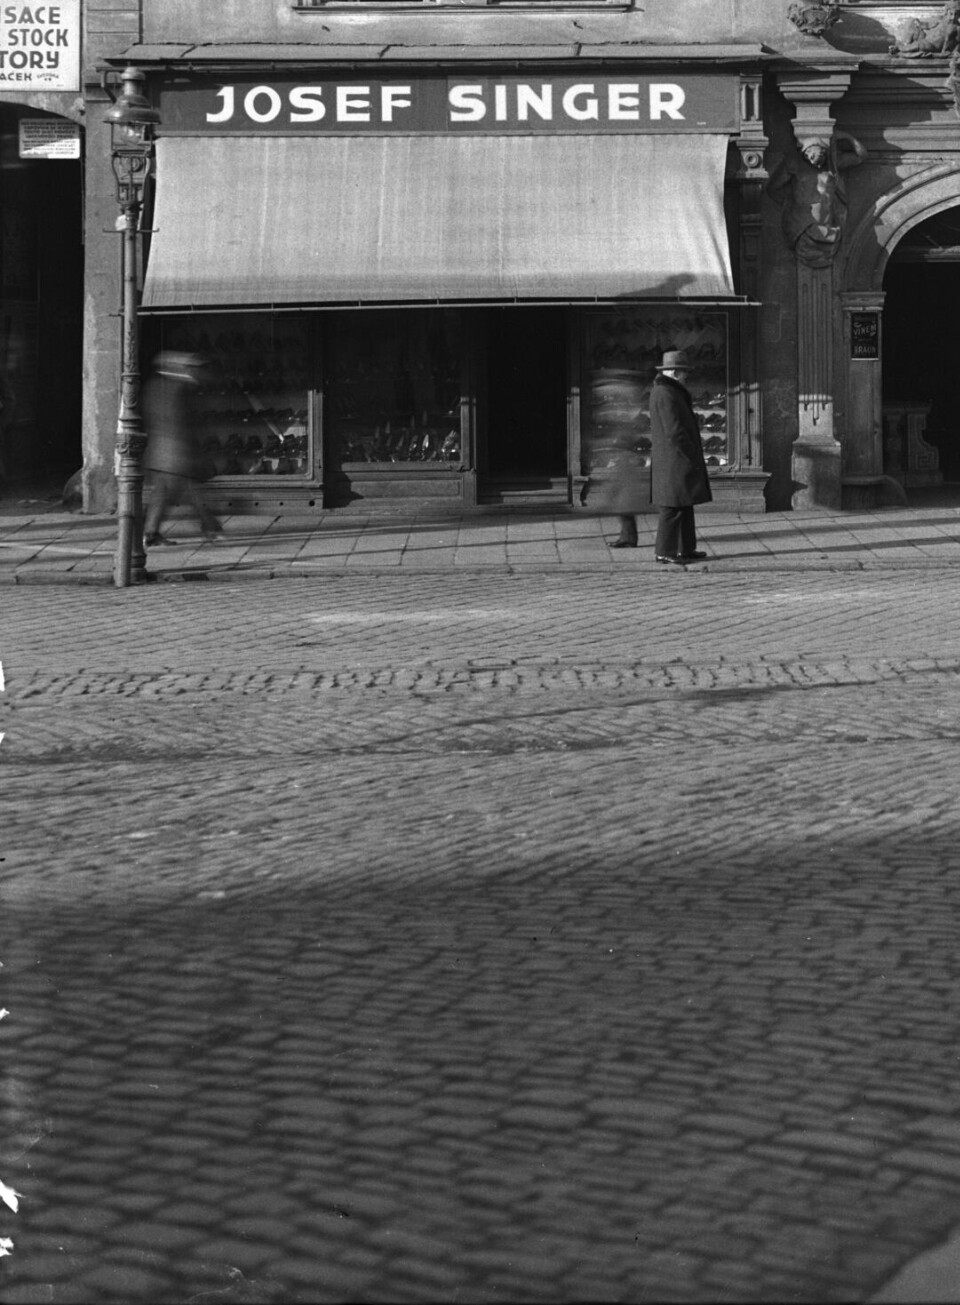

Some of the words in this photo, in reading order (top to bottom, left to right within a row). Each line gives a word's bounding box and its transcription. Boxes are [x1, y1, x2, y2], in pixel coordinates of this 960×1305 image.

[8, 28, 69, 47] STOCK
[206, 85, 412, 123] JOSEF
[448, 82, 686, 122] SINGER
